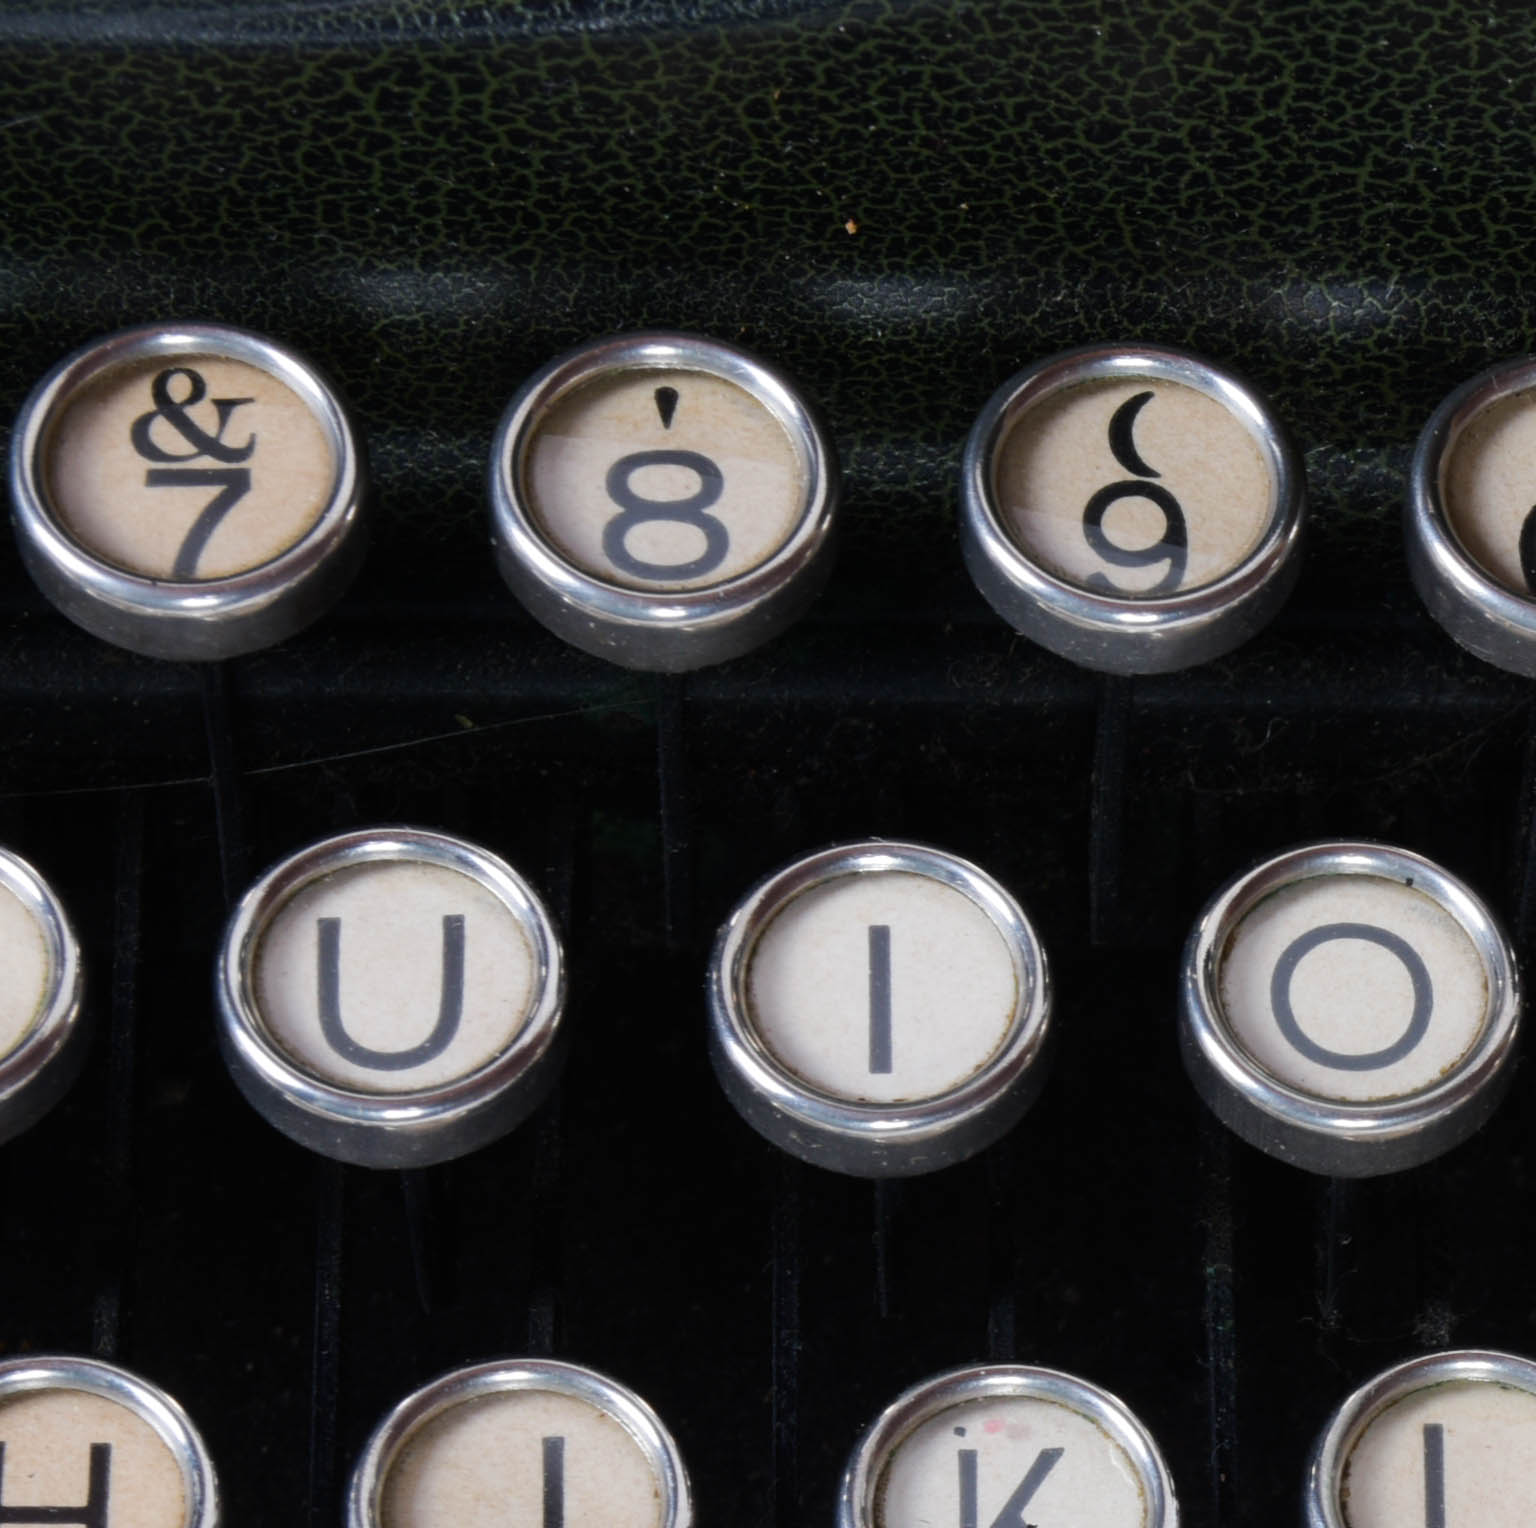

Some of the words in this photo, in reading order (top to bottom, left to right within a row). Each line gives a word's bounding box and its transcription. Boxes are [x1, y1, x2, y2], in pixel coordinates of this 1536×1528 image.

[131, 368, 256, 463] &
[1108, 391, 1162, 478] (
[146, 468, 251, 577] 7
[603, 450, 729, 581] 8
[1083, 480, 1188, 594] 9
[317, 915, 464, 1071] U
[869, 926, 891, 1073] I
[1271, 923, 1433, 1071] O
